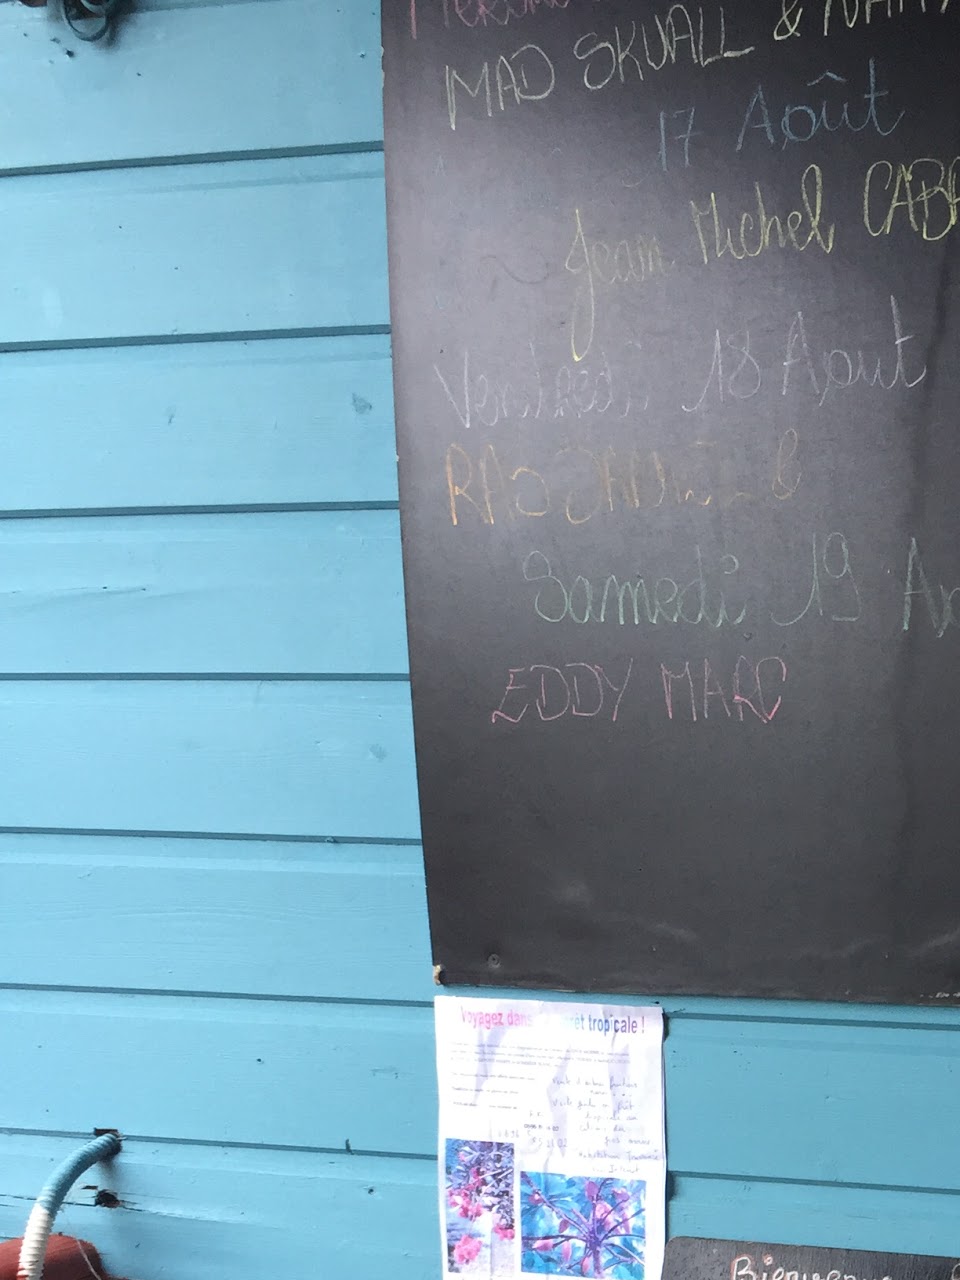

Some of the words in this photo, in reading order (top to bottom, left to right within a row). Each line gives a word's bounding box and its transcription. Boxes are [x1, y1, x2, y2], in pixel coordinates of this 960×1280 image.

[445, 44, 555, 130] MAD
[658, 106, 697, 171] 17
[682, 329, 762, 413] 18
[523, 546, 748, 629] Samedi
[771, 531, 862, 628] 19
[491, 657, 634, 724] EDDY
[588, 1014, 638, 1036] tropicale
